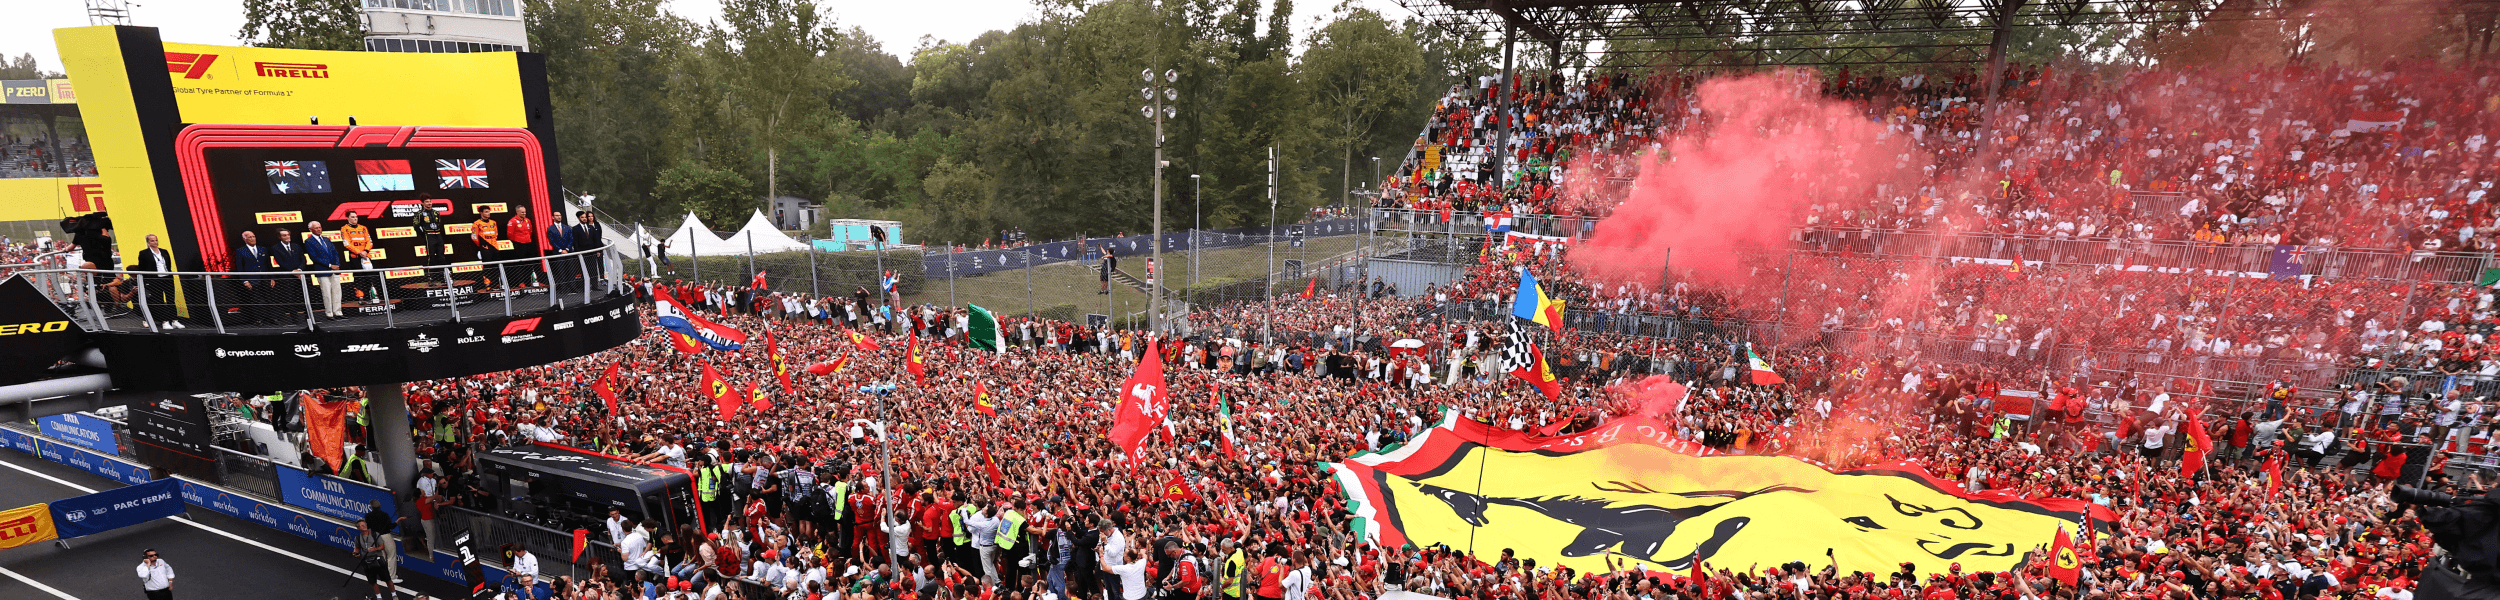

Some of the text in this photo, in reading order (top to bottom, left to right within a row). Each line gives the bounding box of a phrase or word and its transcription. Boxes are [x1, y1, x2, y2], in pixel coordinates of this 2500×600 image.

[254, 61, 329, 79] PIRELLI
[6, 86, 46, 97] P ZERO
[57, 83, 76, 100] PIRE
[195, 87, 213, 96] Tyre
[261, 212, 298, 222] PIRELLI
[381, 228, 412, 237] PIRELLI
[583, 315, 604, 325] aramco
[457, 335, 486, 344] ROLEX
[227, 348, 275, 358] crypto.com
[294, 343, 319, 352] aws
[344, 343, 384, 353] DHL
[62, 413, 80, 425] TATA
[50, 420, 100, 442] COMMUNICATIONS
[41, 449, 62, 462] workday
[69, 456, 91, 471] workday
[98, 465, 121, 480] workday
[320, 478, 346, 495] TATA
[113, 499, 140, 511] PARC
[301, 487, 373, 514] COMMUNICATIONS
[212, 500, 240, 516] workday
[66, 510, 86, 522] FIA
[248, 510, 277, 527] workday
[287, 522, 317, 540] workday
[455, 533, 470, 546] ITALY
[459, 545, 476, 566] 1
